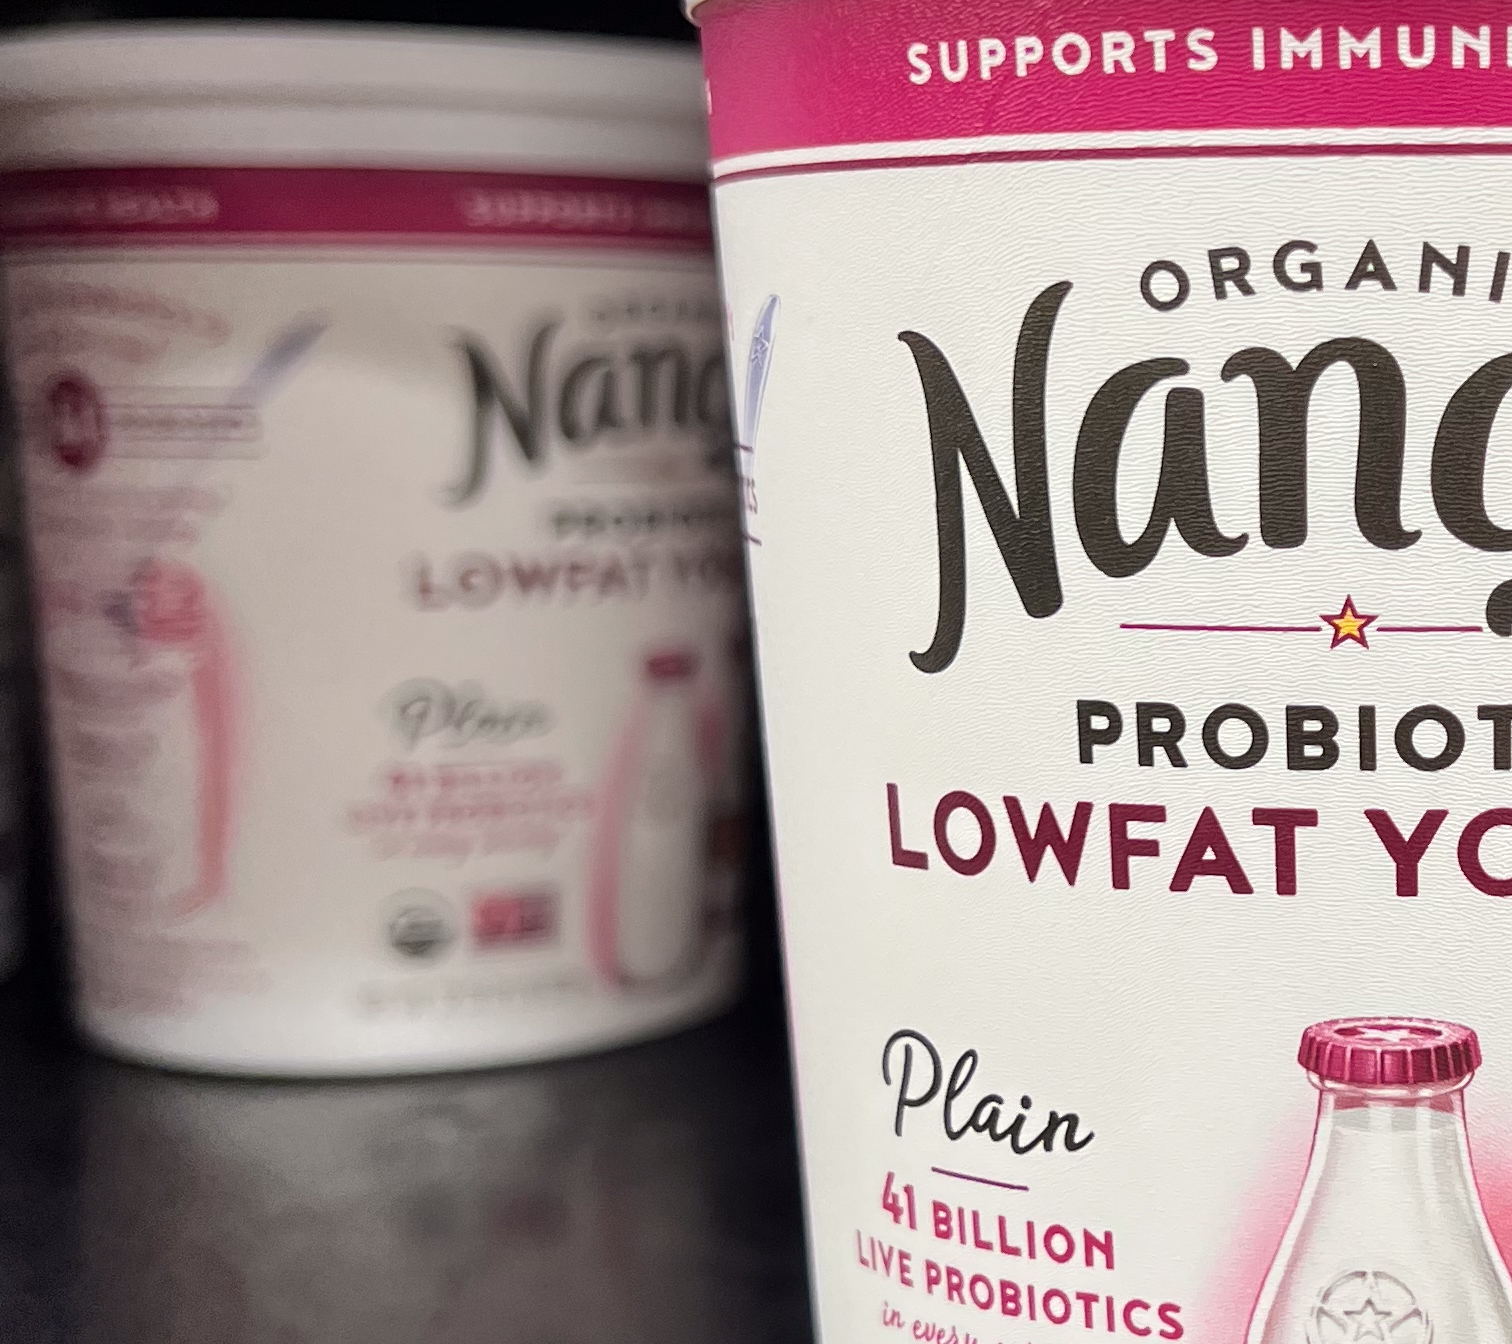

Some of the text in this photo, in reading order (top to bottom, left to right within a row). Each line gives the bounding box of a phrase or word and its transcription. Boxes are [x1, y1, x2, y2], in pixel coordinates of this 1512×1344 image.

[906, 27, 1220, 86] SUPPORTS
[886, 782, 1318, 896] LOWFAT
[882, 1029, 1096, 1156] Plain
[881, 1171, 1116, 1271] 41 BILLION
[856, 1229, 1185, 1341] LIVE PROBIOTICS
[881, 1299, 905, 1330] in
